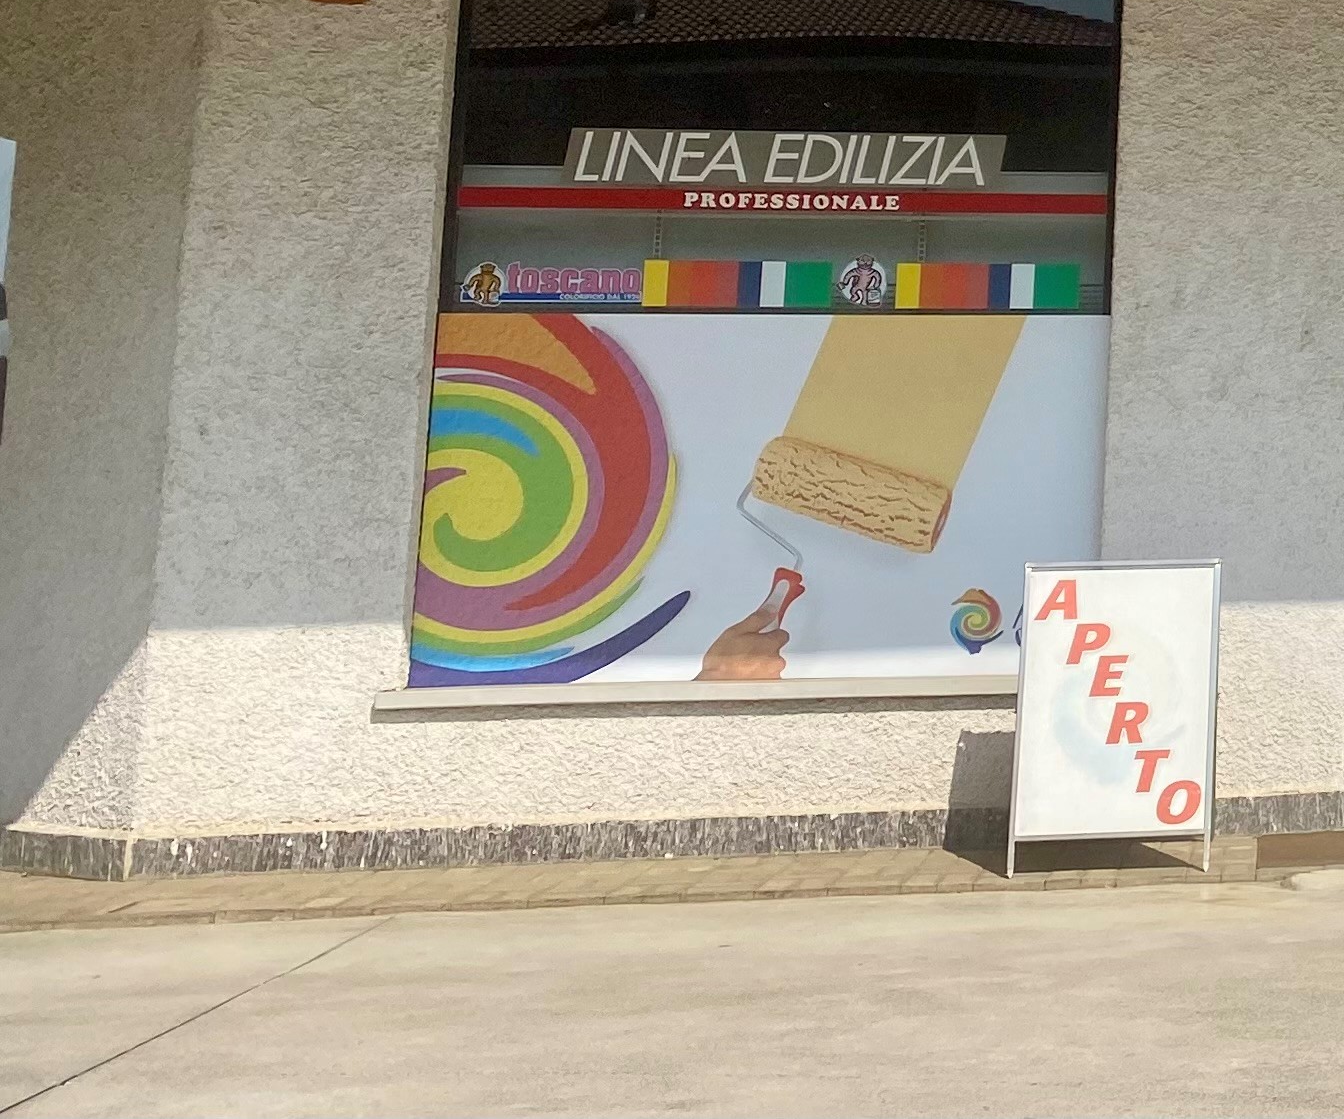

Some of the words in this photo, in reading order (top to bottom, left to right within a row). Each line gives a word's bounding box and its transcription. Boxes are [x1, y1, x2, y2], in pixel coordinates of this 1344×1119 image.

[573, 130, 748, 183] LINEA
[763, 133, 986, 186] EDILIZIA
[683, 191, 901, 212] PROFESSIONALE
[506, 261, 642, 294] toscano
[1034, 579, 1202, 825] APERTO
